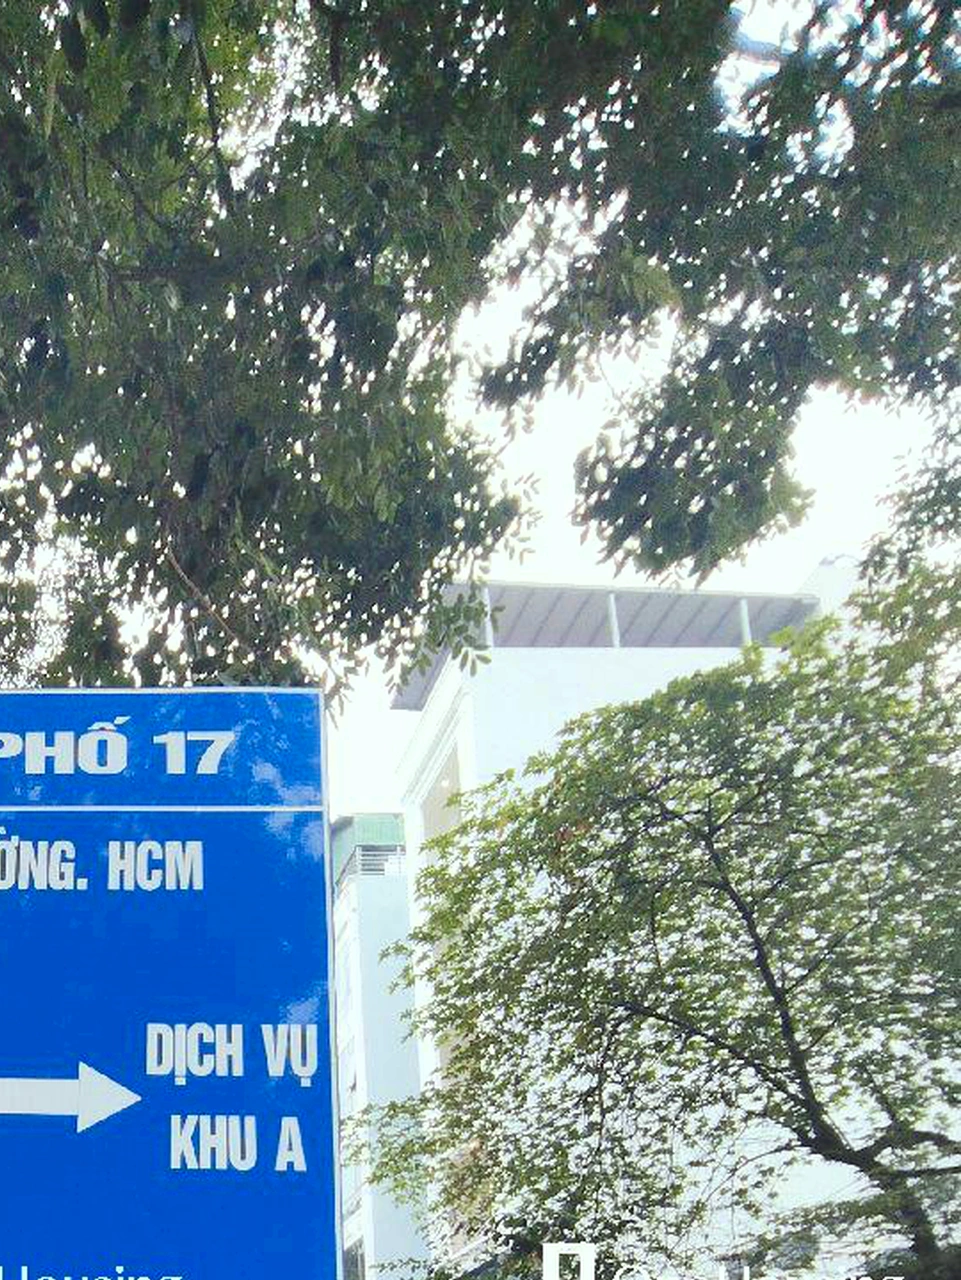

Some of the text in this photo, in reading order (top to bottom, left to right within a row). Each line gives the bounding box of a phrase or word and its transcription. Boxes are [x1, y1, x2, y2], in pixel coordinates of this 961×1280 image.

[153, 731, 236, 774] 17
[108, 840, 203, 891] HCM
[146, 1022, 318, 1087] DỊCH VỤ
[170, 1114, 307, 1171] KHU A
